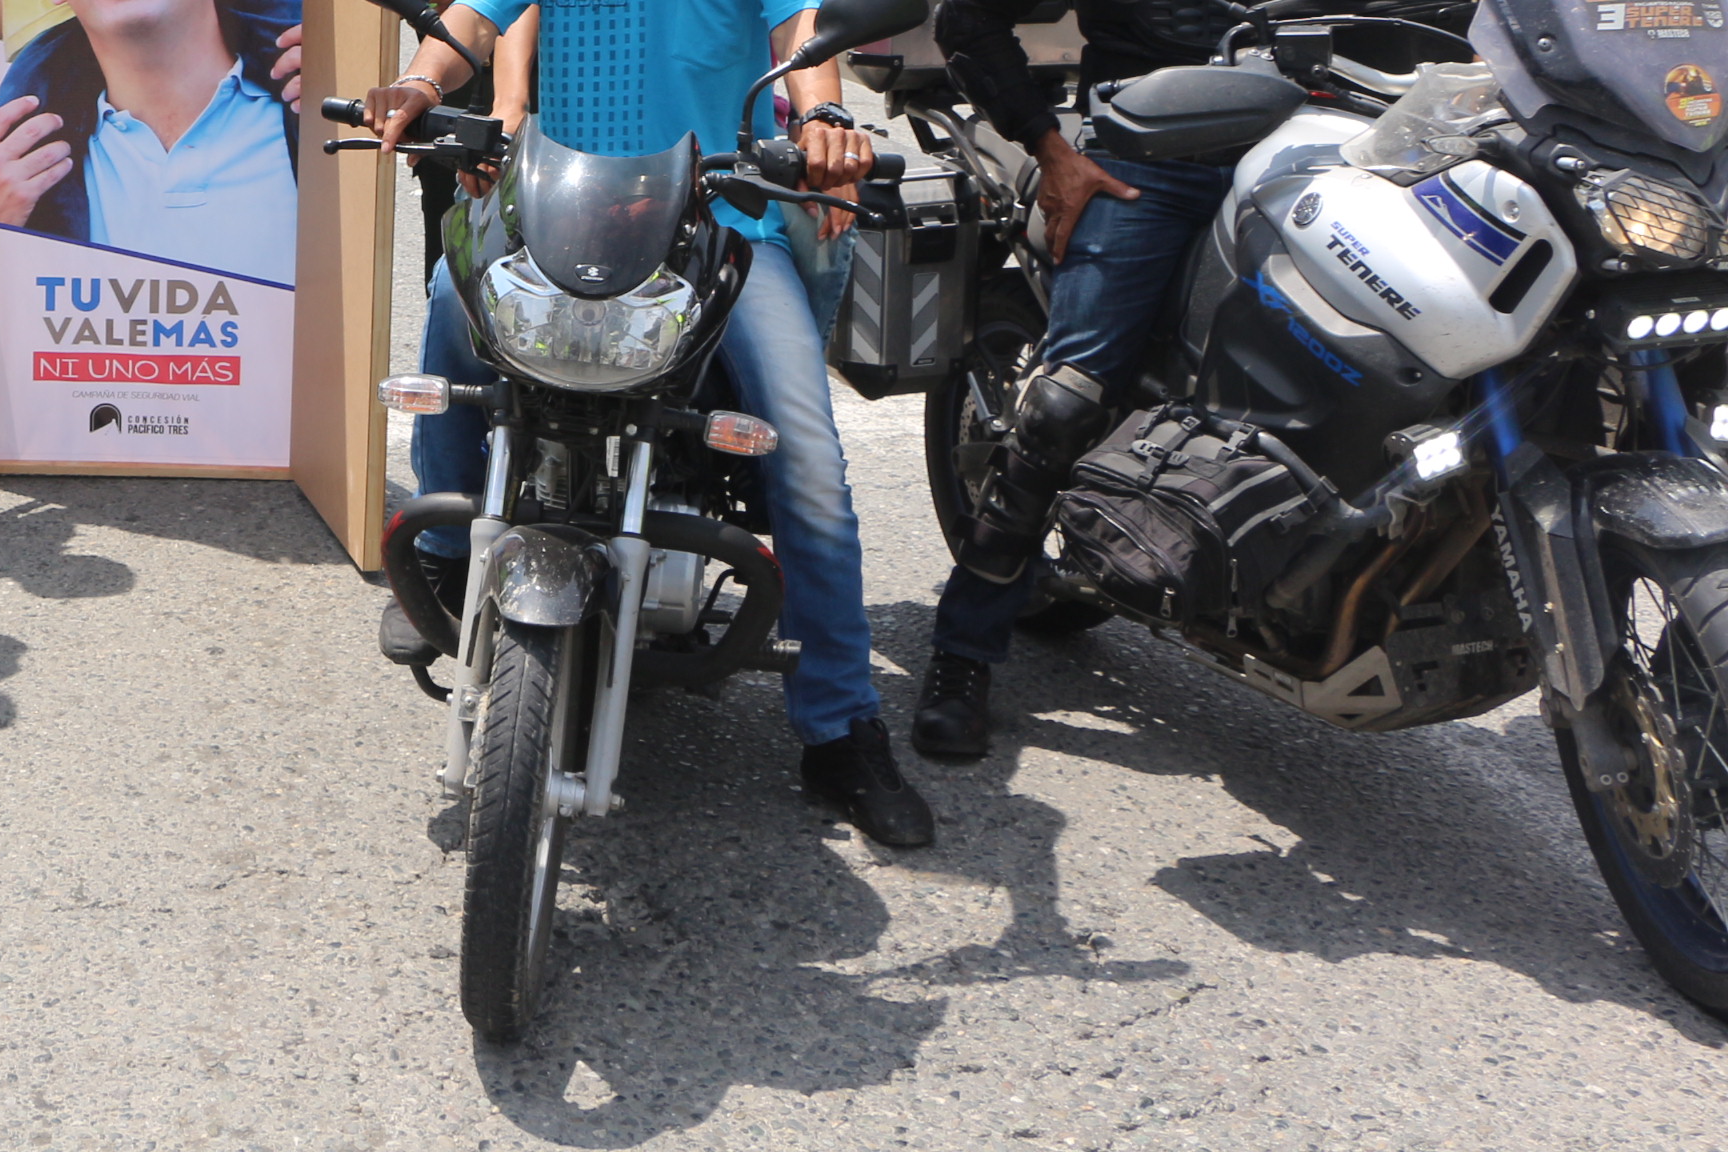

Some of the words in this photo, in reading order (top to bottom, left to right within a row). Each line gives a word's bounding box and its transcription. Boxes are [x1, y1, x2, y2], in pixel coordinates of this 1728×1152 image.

[1597, 3, 1626, 30] 3
[1329, 220, 1371, 258] SUPER
[39, 357, 80, 378] NI
[87, 359, 160, 380] UNO
[168, 357, 234, 382] MÁS
[72, 389, 115, 399] CAMPAÑA
[117, 391, 128, 399] DE
[131, 391, 181, 401] SEGURIDAD
[182, 393, 200, 402] VIAL
[127, 414, 190, 425] CONCESIÓN
[127, 423, 165, 434] PACÍFICO
[168, 424, 189, 435] TRES
[1490, 502, 1533, 634] YAMAHA
